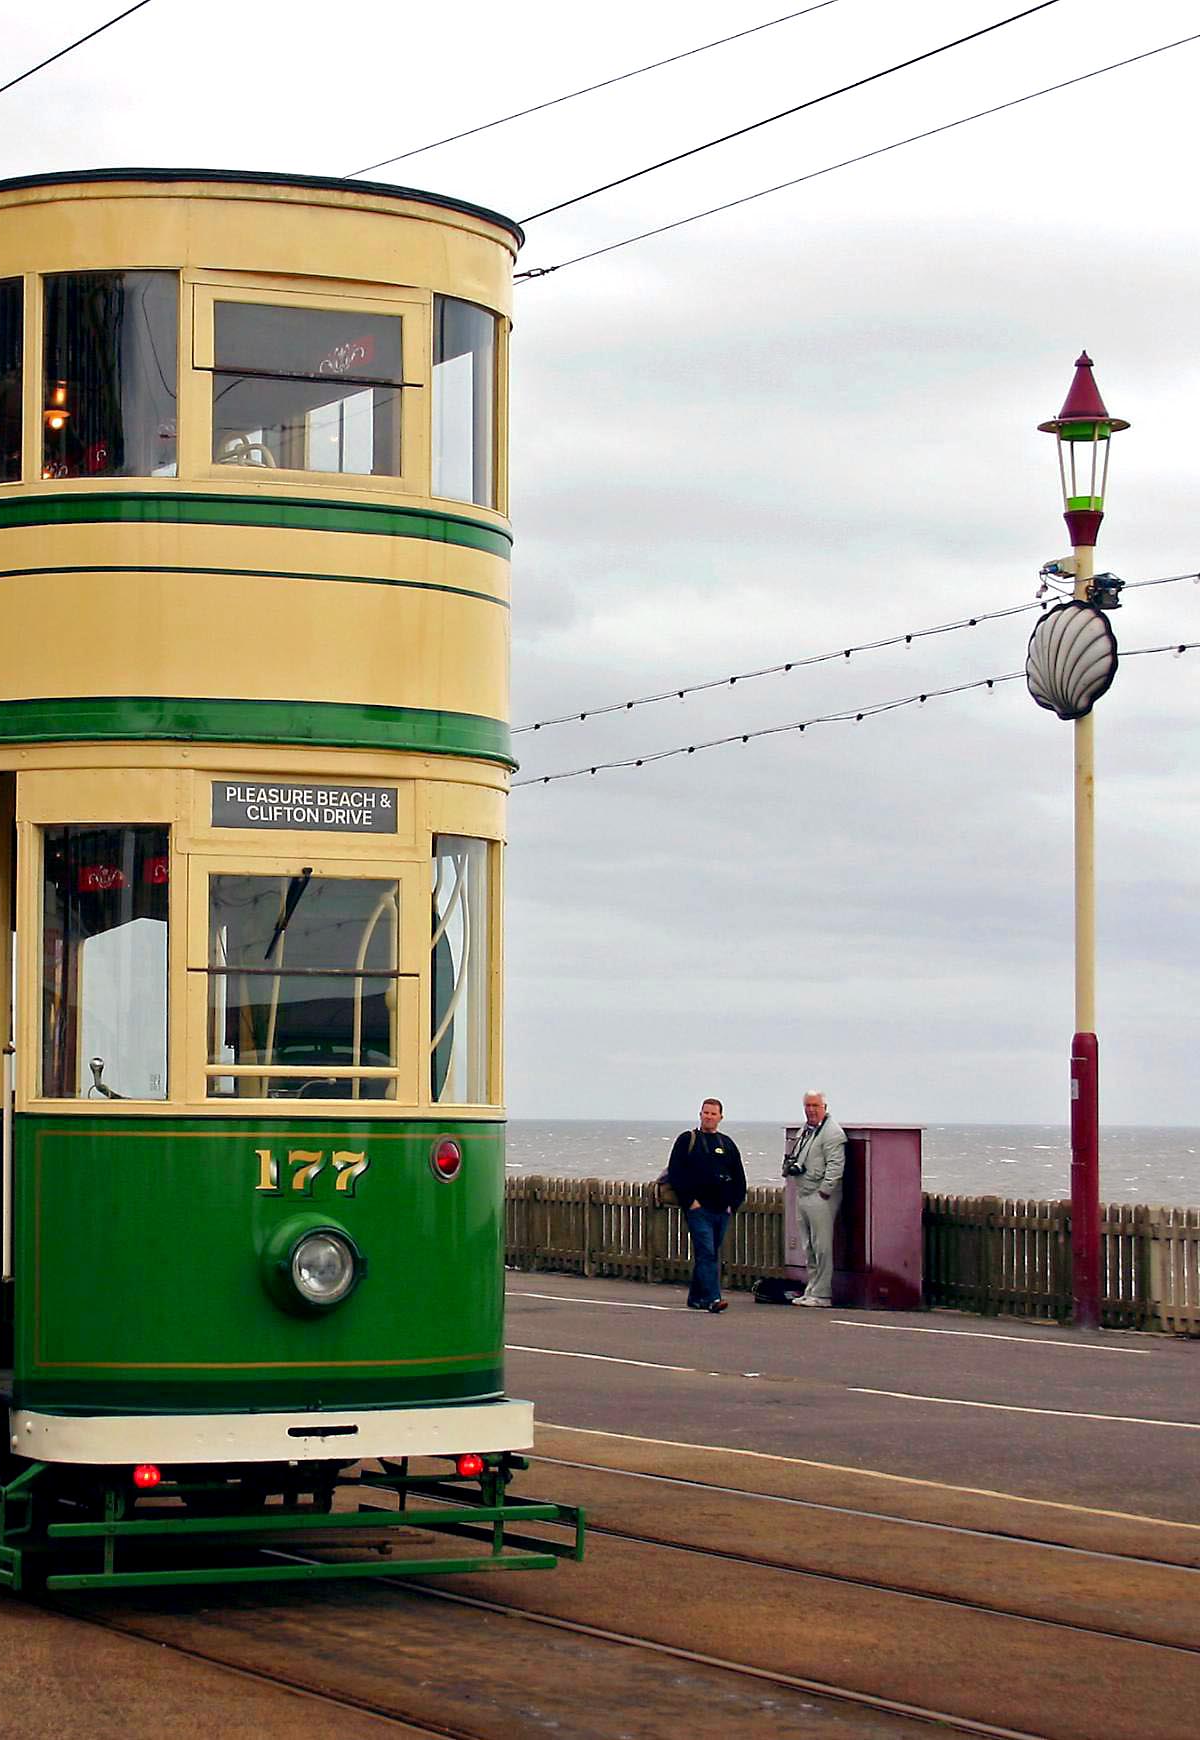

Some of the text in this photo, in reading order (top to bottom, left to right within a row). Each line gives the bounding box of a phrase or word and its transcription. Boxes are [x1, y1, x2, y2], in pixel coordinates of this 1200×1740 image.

[225, 786, 392, 808] PLEASURE BEACH &
[246, 805, 373, 825] CLIFTON DRIVE
[255, 1149, 371, 1198] 177
